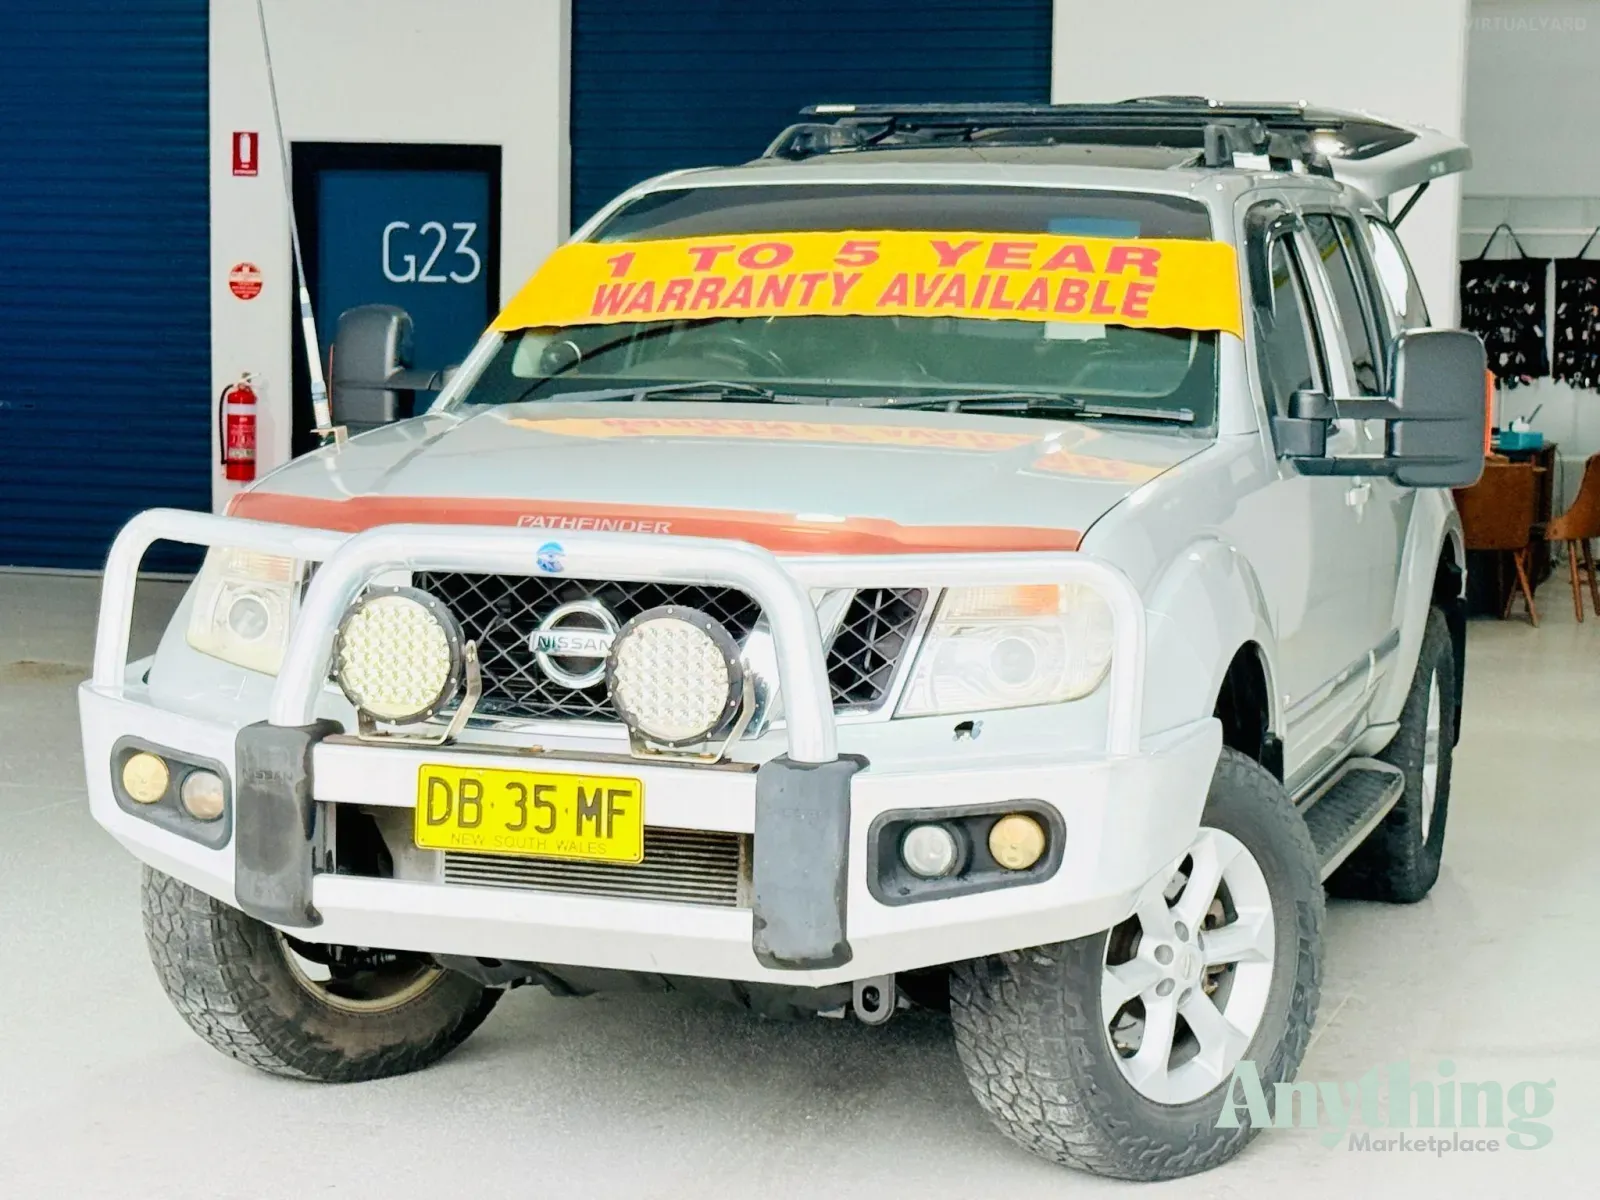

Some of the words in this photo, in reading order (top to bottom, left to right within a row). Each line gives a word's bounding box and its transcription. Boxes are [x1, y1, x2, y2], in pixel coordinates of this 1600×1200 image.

[382, 221, 481, 283] G23
[606, 252, 636, 278] 1
[688, 242, 794, 272] TO
[833, 240, 881, 267] 5
[930, 240, 1162, 278] YEAR
[590, 271, 863, 316] WARRANTY
[875, 272, 1156, 319] AVAILABLE
[516, 514, 673, 534] PATHFINDER
[537, 635, 610, 652] NISSAN
[426, 776, 484, 828] DB
[504, 781, 558, 834] 35
[576, 786, 633, 839] MF
[450, 832, 484, 846] NEW
[494, 834, 547, 850] SOUTH
[556, 840, 608, 854] WALES
